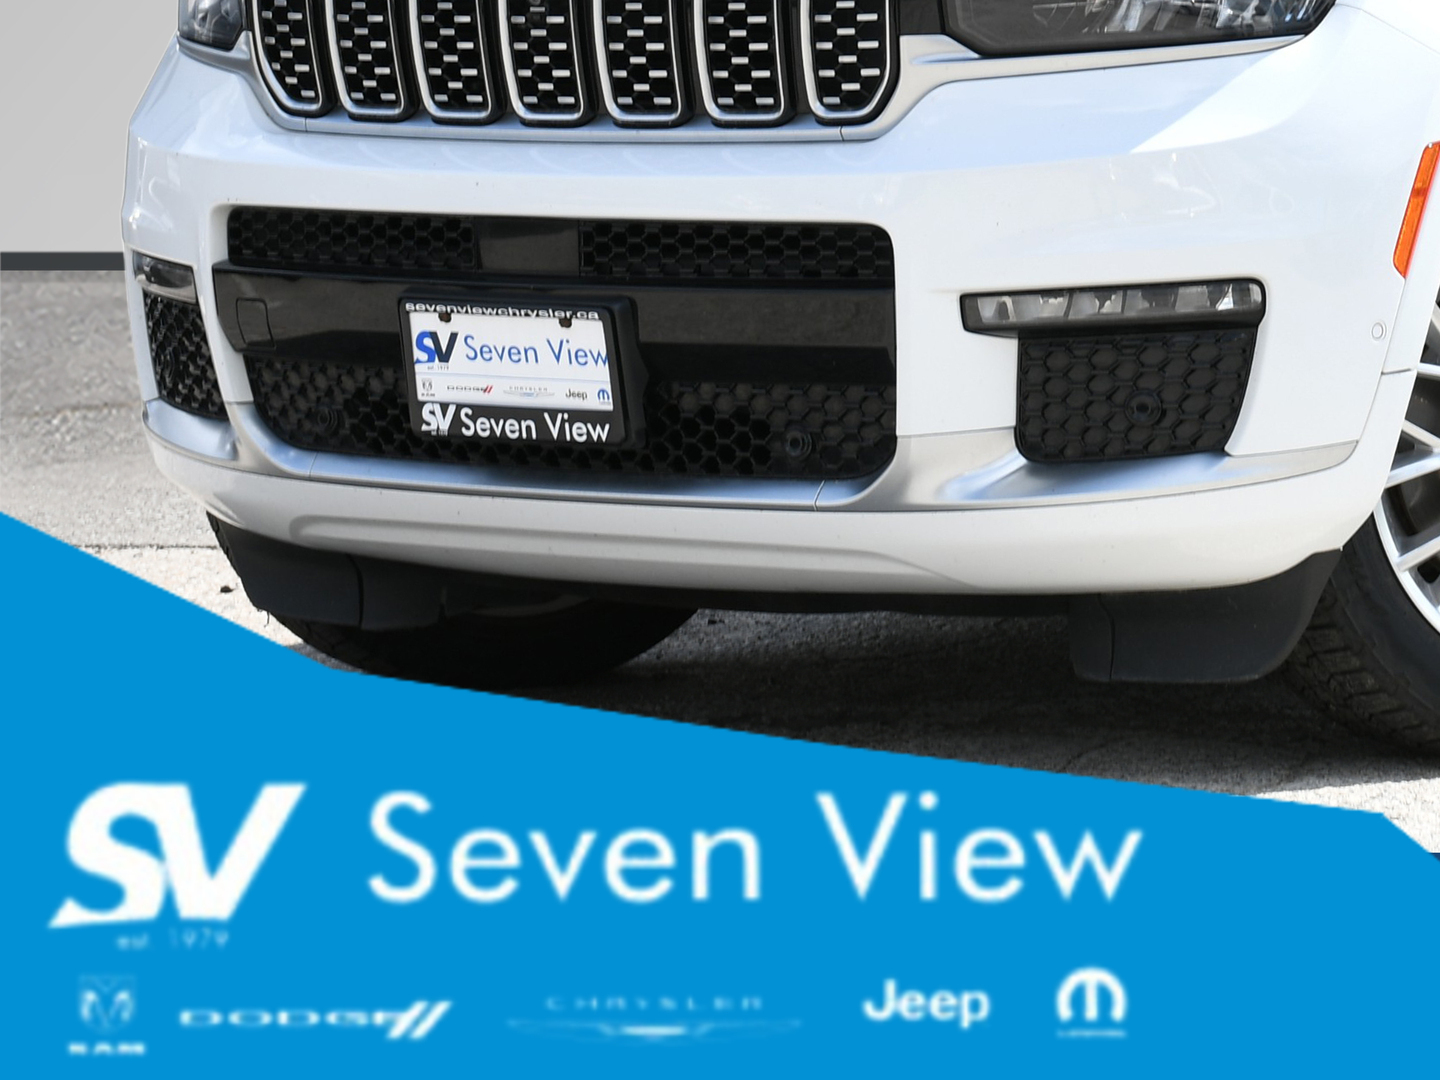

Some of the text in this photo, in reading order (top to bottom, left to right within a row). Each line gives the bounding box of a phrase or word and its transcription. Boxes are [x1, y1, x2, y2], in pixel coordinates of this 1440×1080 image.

[405, 302, 599, 320] sevenviewchrysler.ca
[414, 330, 610, 368] SV Seven View
[565, 388, 588, 401] Jeep
[421, 402, 610, 444] SV Seven View
